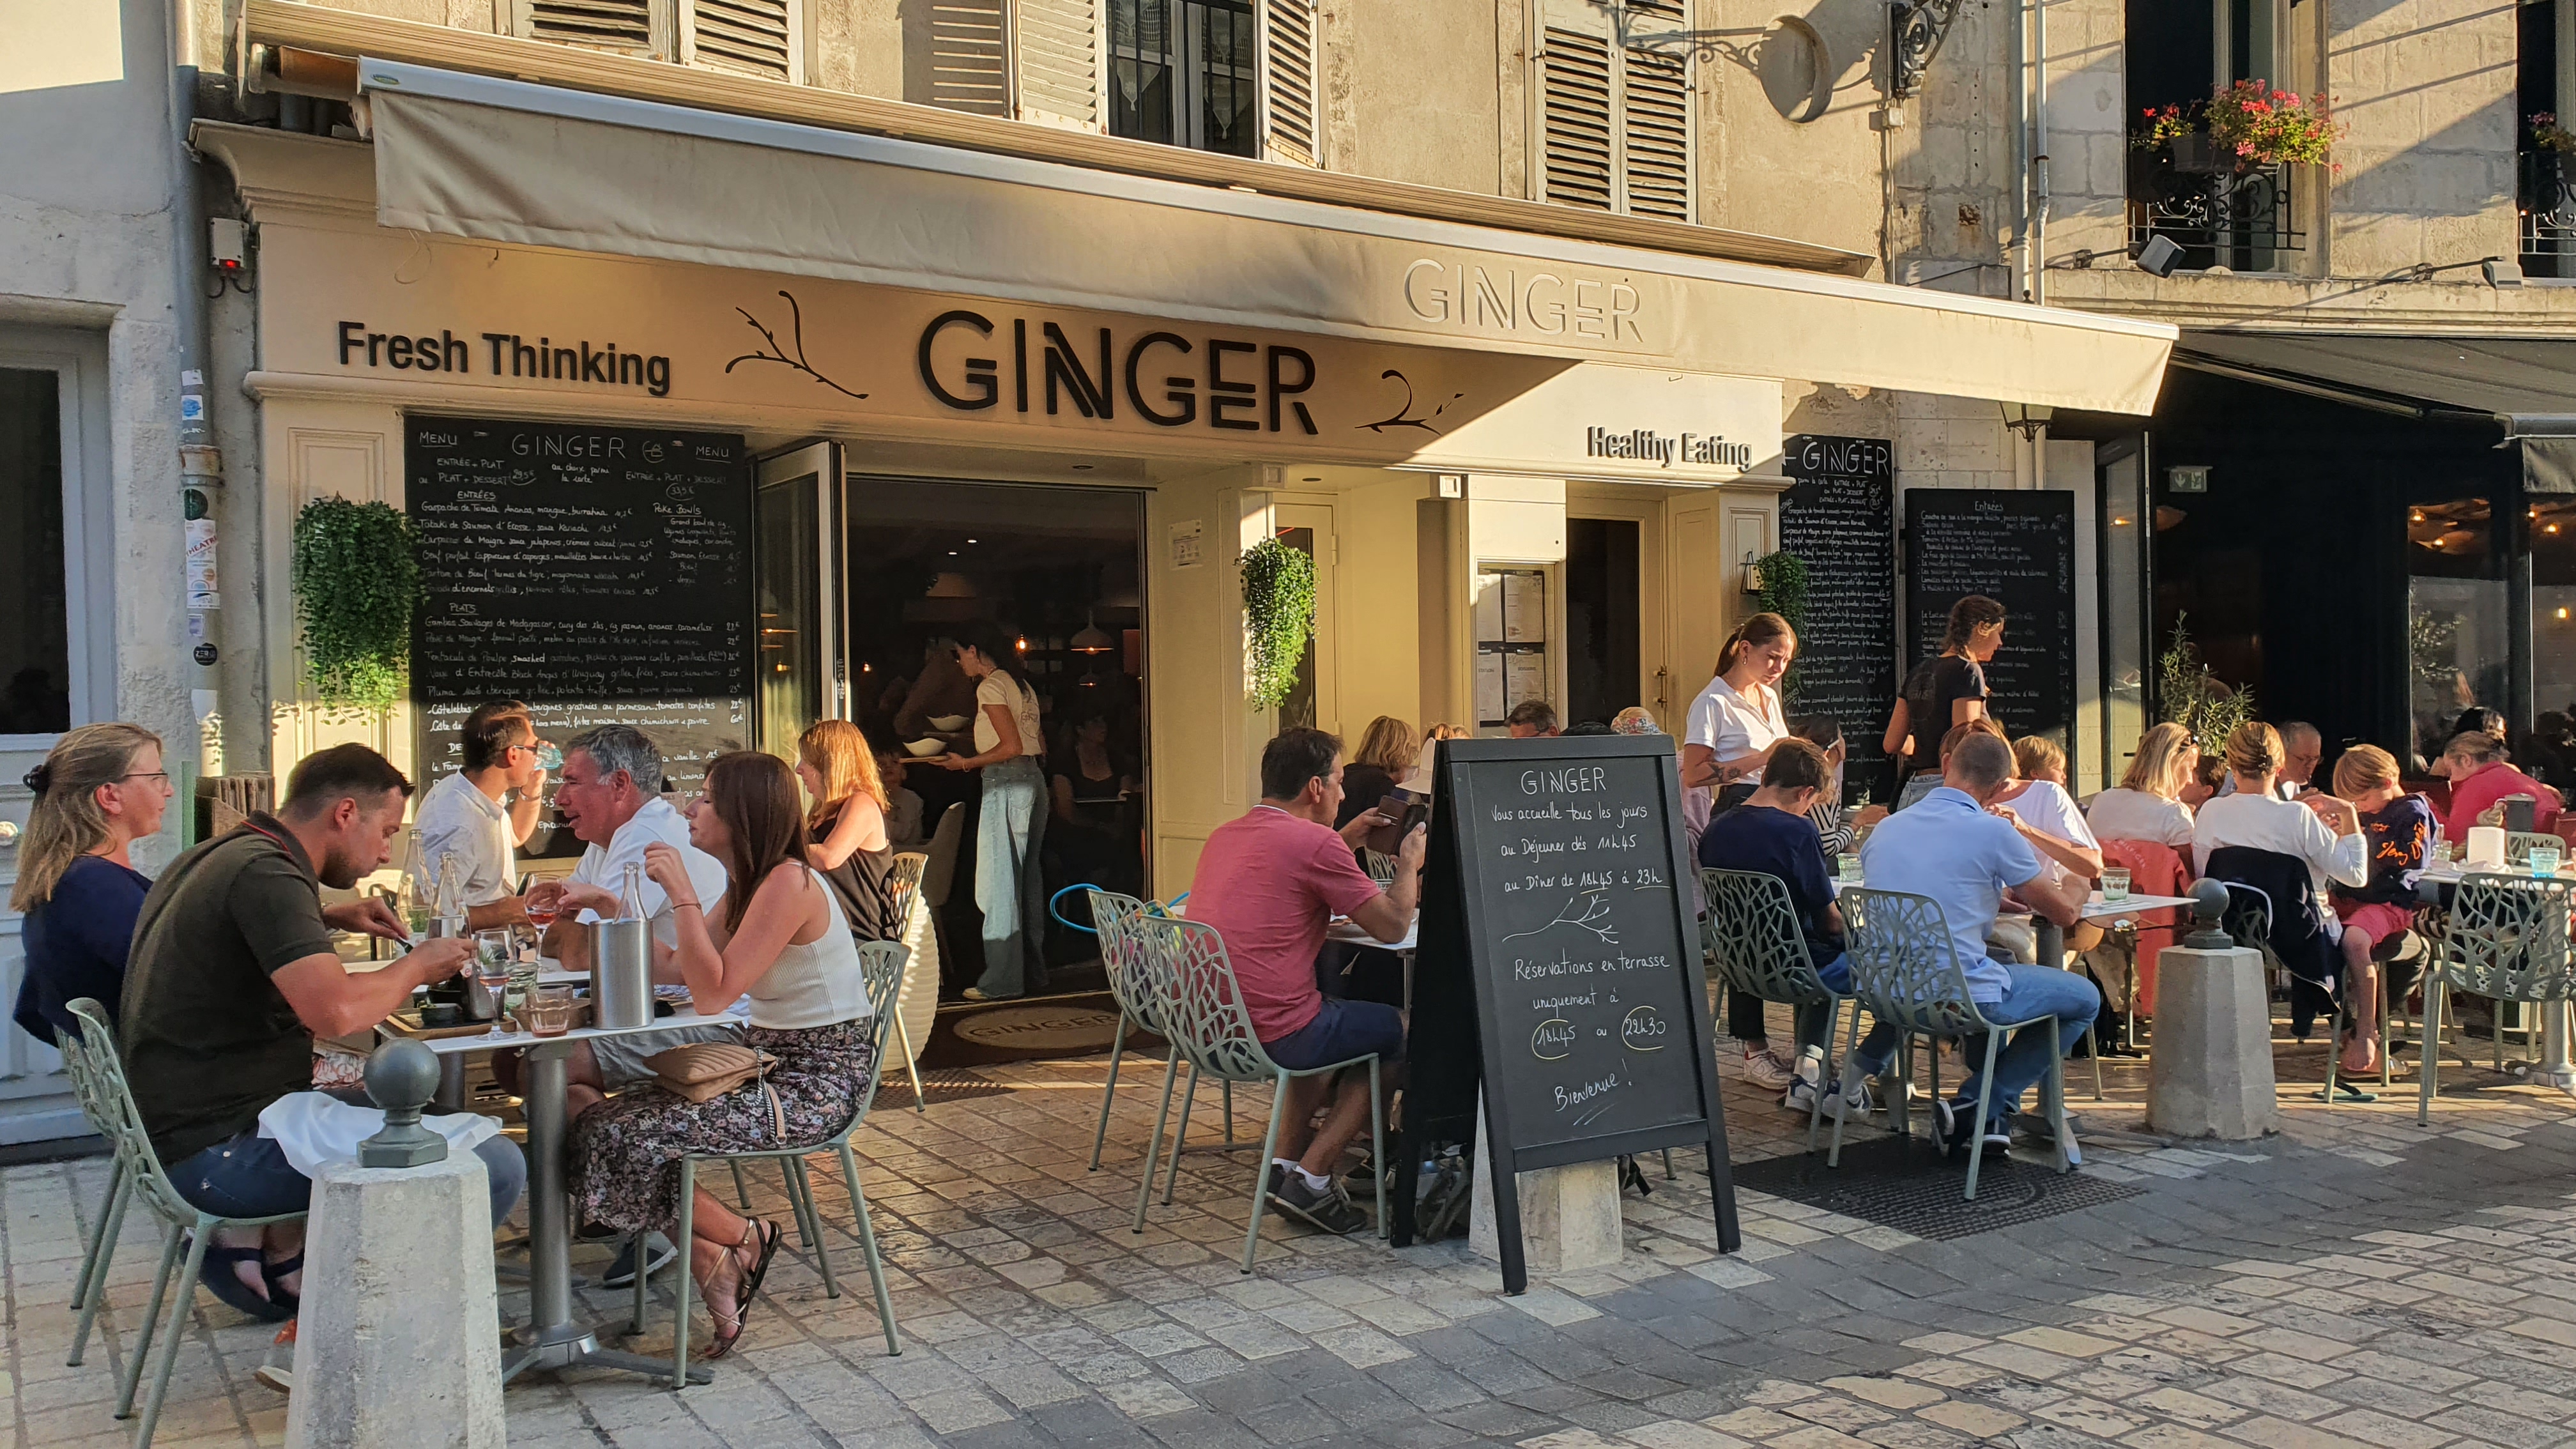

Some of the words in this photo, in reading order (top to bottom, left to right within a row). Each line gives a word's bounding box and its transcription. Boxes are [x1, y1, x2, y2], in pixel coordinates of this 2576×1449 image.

[1404, 258, 1643, 343] GINGER
[339, 321, 468, 373] Fresh
[482, 332, 670, 397] Thinking
[918, 310, 1318, 434] GINGER
[420, 431, 457, 445] MENU
[512, 434, 625, 458] GINGER
[696, 447, 728, 457] MENU
[1587, 426, 1676, 468] Healthy
[1682, 433, 1752, 474] Eating
[1804, 441, 1889, 475] GINGER
[436, 457, 470, 466] ENTRÉE
[481, 459, 505, 469] PLAT
[438, 472, 462, 482] PLAT
[473, 475, 510, 486] DESSERT
[626, 471, 654, 480] ENTRÉE
[664, 473, 684, 482] PLAT
[457, 490, 496, 499] ENTRÉES
[422, 501, 459, 514] Gaspacho
[461, 503, 470, 511] de
[653, 502, 672, 514] Poke
[677, 503, 702, 514] Bowls
[1975, 500, 2004, 511] Entrées
[450, 519, 459, 528] de
[463, 521, 493, 530] Saumon
[479, 537, 505, 548] Maigre
[449, 602, 477, 613] PLATS
[425, 616, 456, 628] Gambas
[458, 618, 493, 632] Sauvages
[496, 618, 505, 627] de
[511, 652, 545, 663] smashed
[427, 686, 457, 697] Pluma
[526, 702, 562, 716] ubergines
[564, 700, 597, 715] gratinées
[657, 698, 684, 711] tomates
[688, 698, 715, 713] confites
[730, 698, 742, 710] 22€
[430, 719, 450, 732] Côte
[452, 720, 462, 730] de
[687, 719, 710, 729] poivre
[730, 714, 743, 723] 60€
[674, 749, 700, 760] vanille
[706, 749, 717, 759] 12€
[1521, 767, 1607, 795] GINGER
[1491, 804, 1513, 822] Vous
[1518, 801, 1562, 820] accueille
[1566, 802, 1592, 821] tous
[1598, 802, 1611, 819] les
[1616, 801, 1648, 829] jours
[1501, 847, 1515, 856] au
[1521, 835, 1564, 863] Déjeuner
[1598, 834, 1636, 852] 11h45
[1505, 882, 1520, 893] au
[1526, 877, 1555, 891] Dîner
[1561, 873, 1574, 887] de
[1580, 871, 1613, 891] 18h45
[1637, 868, 1662, 885] 23h
[1515, 947, 1593, 981] Réservations
[1601, 960, 1616, 972] en
[1618, 950, 1670, 971] terrasse
[1533, 983, 1597, 1018] uniquement
[969, 1015, 1115, 1038] GINGER
[1537, 1025, 1575, 1047] 18h45
[1597, 1027, 1607, 1036] ou
[1625, 1017, 1666, 1036] 22h30
[1554, 1073, 1621, 1112] Bienvenue
